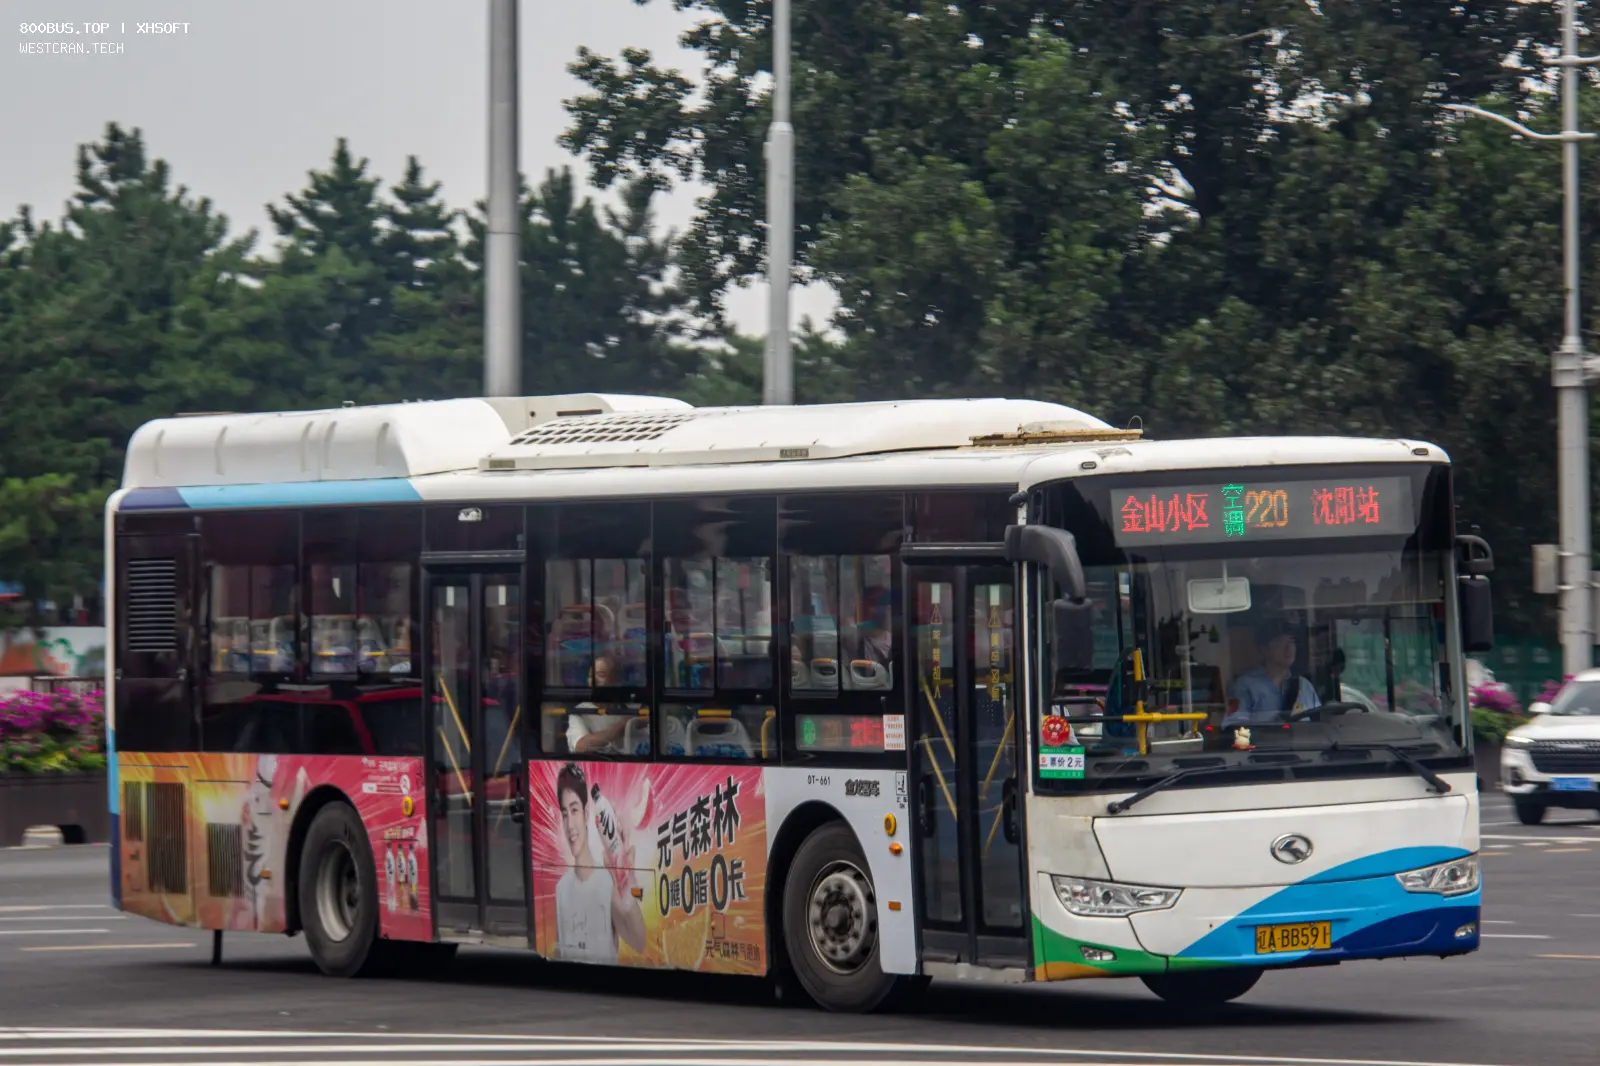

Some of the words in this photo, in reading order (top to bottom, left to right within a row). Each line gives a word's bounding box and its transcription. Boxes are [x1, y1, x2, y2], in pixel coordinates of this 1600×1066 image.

[1121, 494, 1209, 533] 金山小区
[1221, 483, 1244, 537] 空调
[1245, 489, 1288, 527] 220
[1311, 486, 1380, 525] 沈阳站
[656, 774, 742, 872] 元气森林
